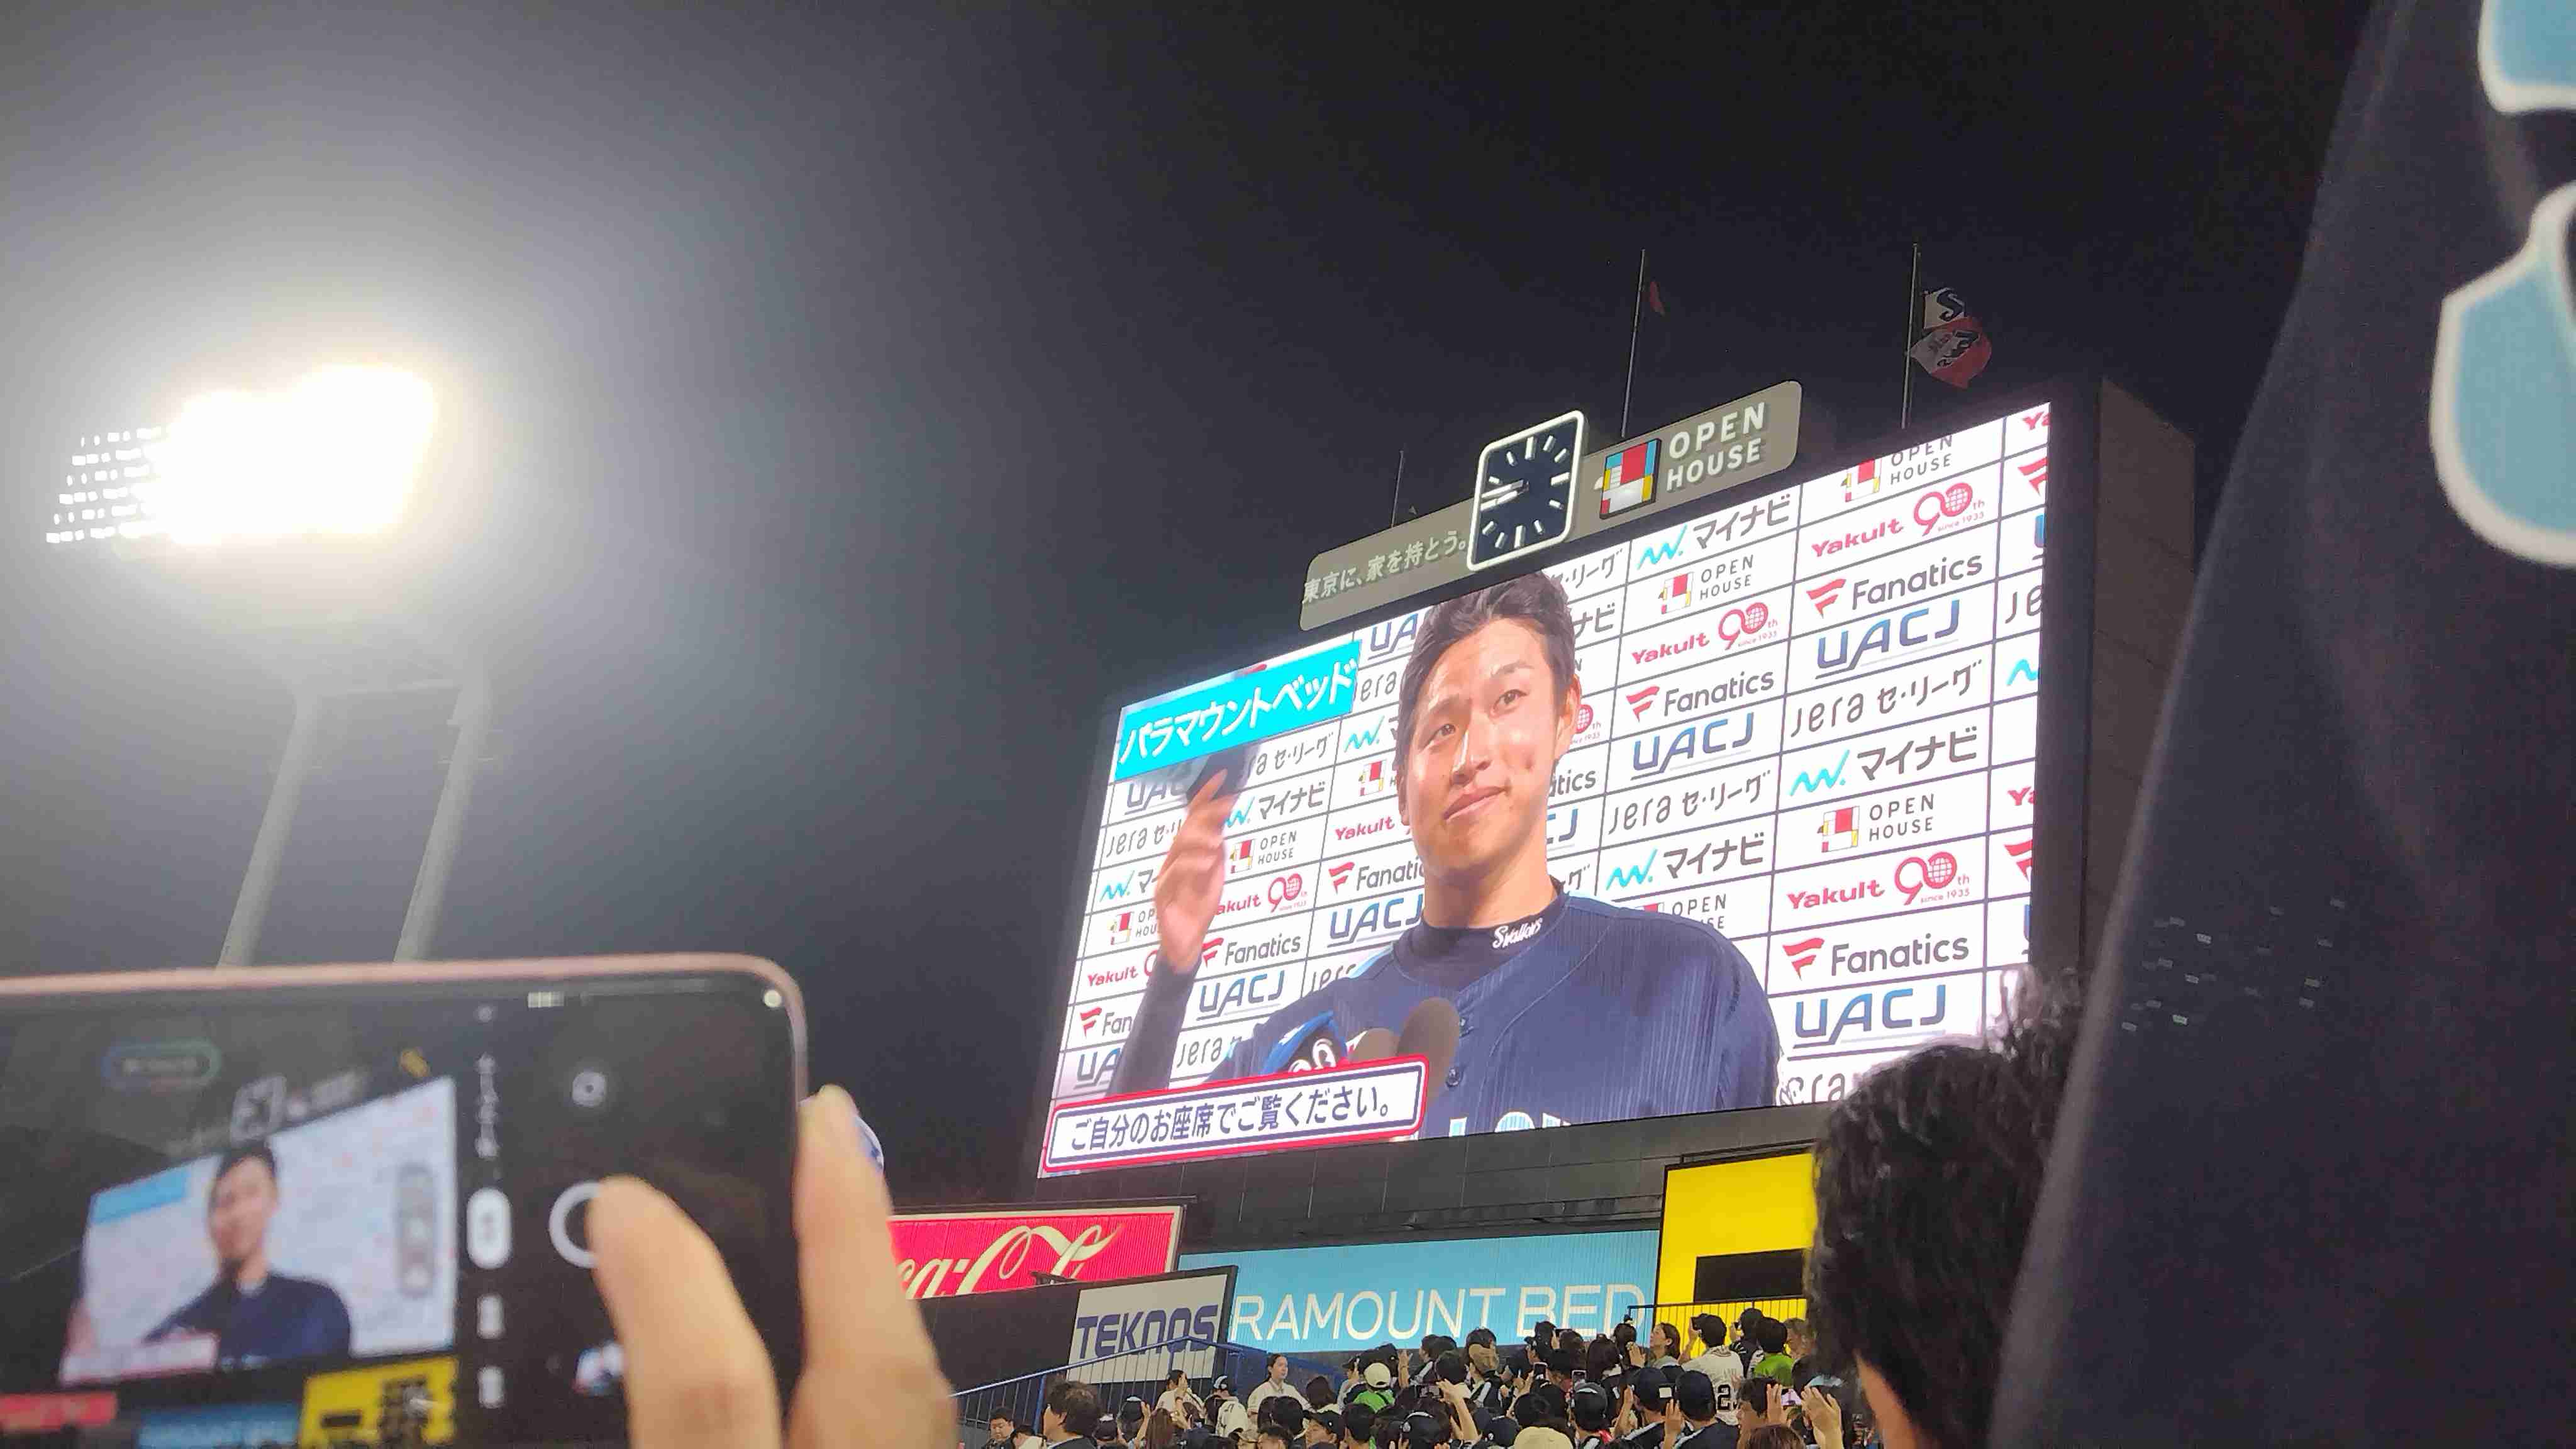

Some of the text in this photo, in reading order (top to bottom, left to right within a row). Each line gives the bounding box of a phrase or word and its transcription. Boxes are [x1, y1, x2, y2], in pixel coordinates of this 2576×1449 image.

[1669, 402, 1765, 458] OPEN
[1667, 438, 1762, 491] HOUSE
[1890, 453, 1951, 485] HOUSE
[1693, 494, 1790, 549] マイナビ
[1811, 518, 1904, 557] Yakult
[1302, 530, 1466, 604] 東京に、家を持とう。
[1700, 574, 1752, 600] HOUSE
[1701, 554, 1754, 583] OPEN
[1852, 555, 1982, 610] Fanatics
[1631, 633, 1710, 665] Yakult
[1816, 599, 1960, 679] UACJ
[1664, 671, 1774, 716] Fanatics
[1877, 659, 1982, 714] セ・リーグ
[1119, 658, 1357, 764] パラマウントベッド
[1274, 731, 1333, 770] セ・リーグ
[1631, 712, 1754, 780] UACJ
[1857, 726, 1977, 781] マイナビ
[1258, 782, 1325, 819] マイナビ
[1682, 770, 1770, 817] セ・リーグ
[1869, 793, 1935, 821] OPEN
[1260, 830, 1297, 850] OPEN
[1335, 816, 1395, 840] Yakult
[1868, 817, 1933, 841] HOUSE
[1258, 848, 1294, 865] HOUSE
[1663, 832, 1764, 879] マイナビ
[1672, 893, 1726, 916] OPEN
[1787, 880, 1885, 909] Yakult
[1327, 893, 1423, 948] UACJ
[1225, 933, 1301, 966] Fanatics
[1831, 933, 1969, 976] Fanatics
[1087, 965, 1139, 987] Yakult
[1196, 970, 1285, 1021] UACJ
[1792, 984, 1946, 1049] UACJ
[1072, 1085, 1388, 1151] ご自分のお座席でご覧ください。
[1076, 1304, 1219, 1359] TEKNOS
[1230, 1284, 1646, 1341] RAMOUNT BED
